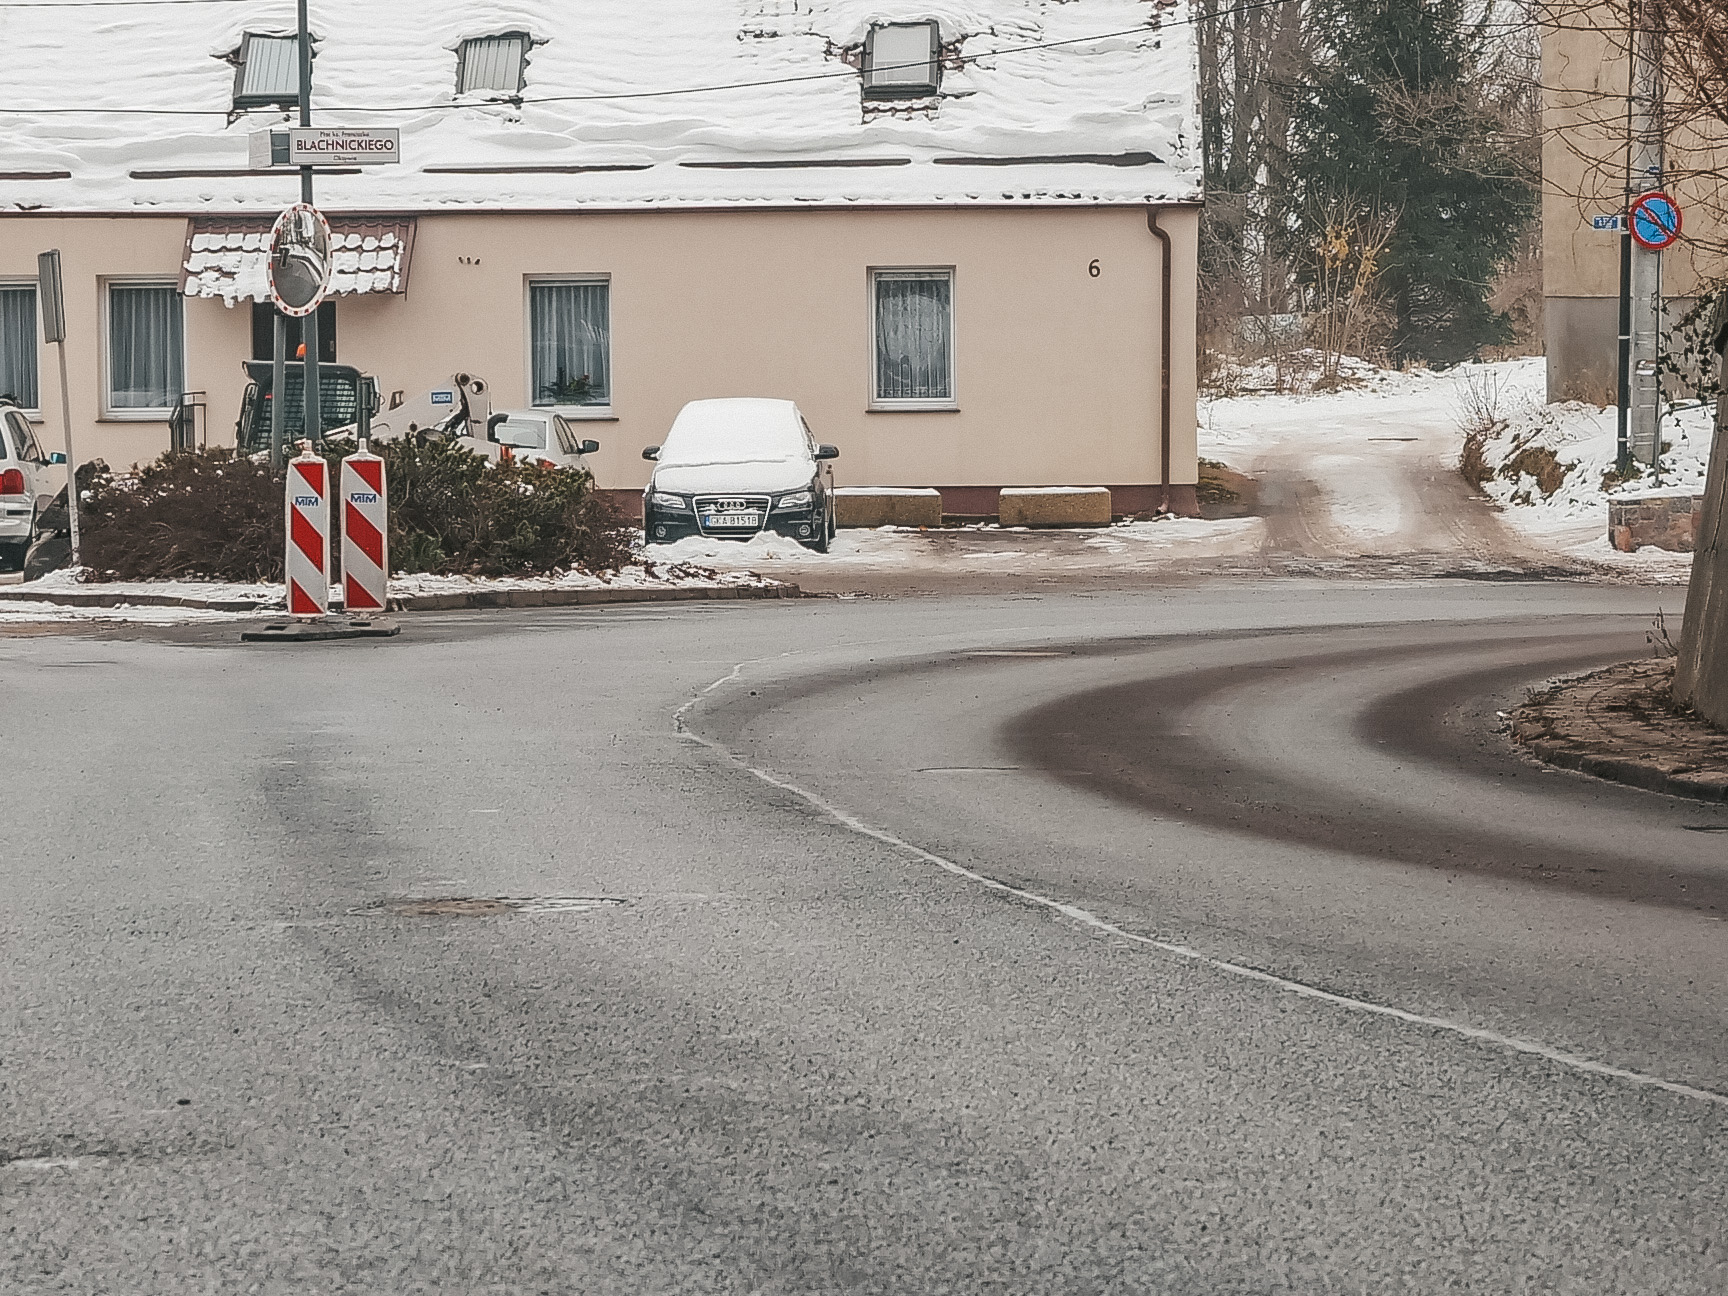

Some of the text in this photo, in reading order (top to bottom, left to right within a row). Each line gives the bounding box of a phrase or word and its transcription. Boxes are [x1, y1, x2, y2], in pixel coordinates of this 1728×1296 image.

[296, 139, 394, 151] BLACHNICKIEGO
[1088, 258, 1101, 278] 6
[295, 496, 318, 506] MTM
[351, 493, 376, 503] MTM
